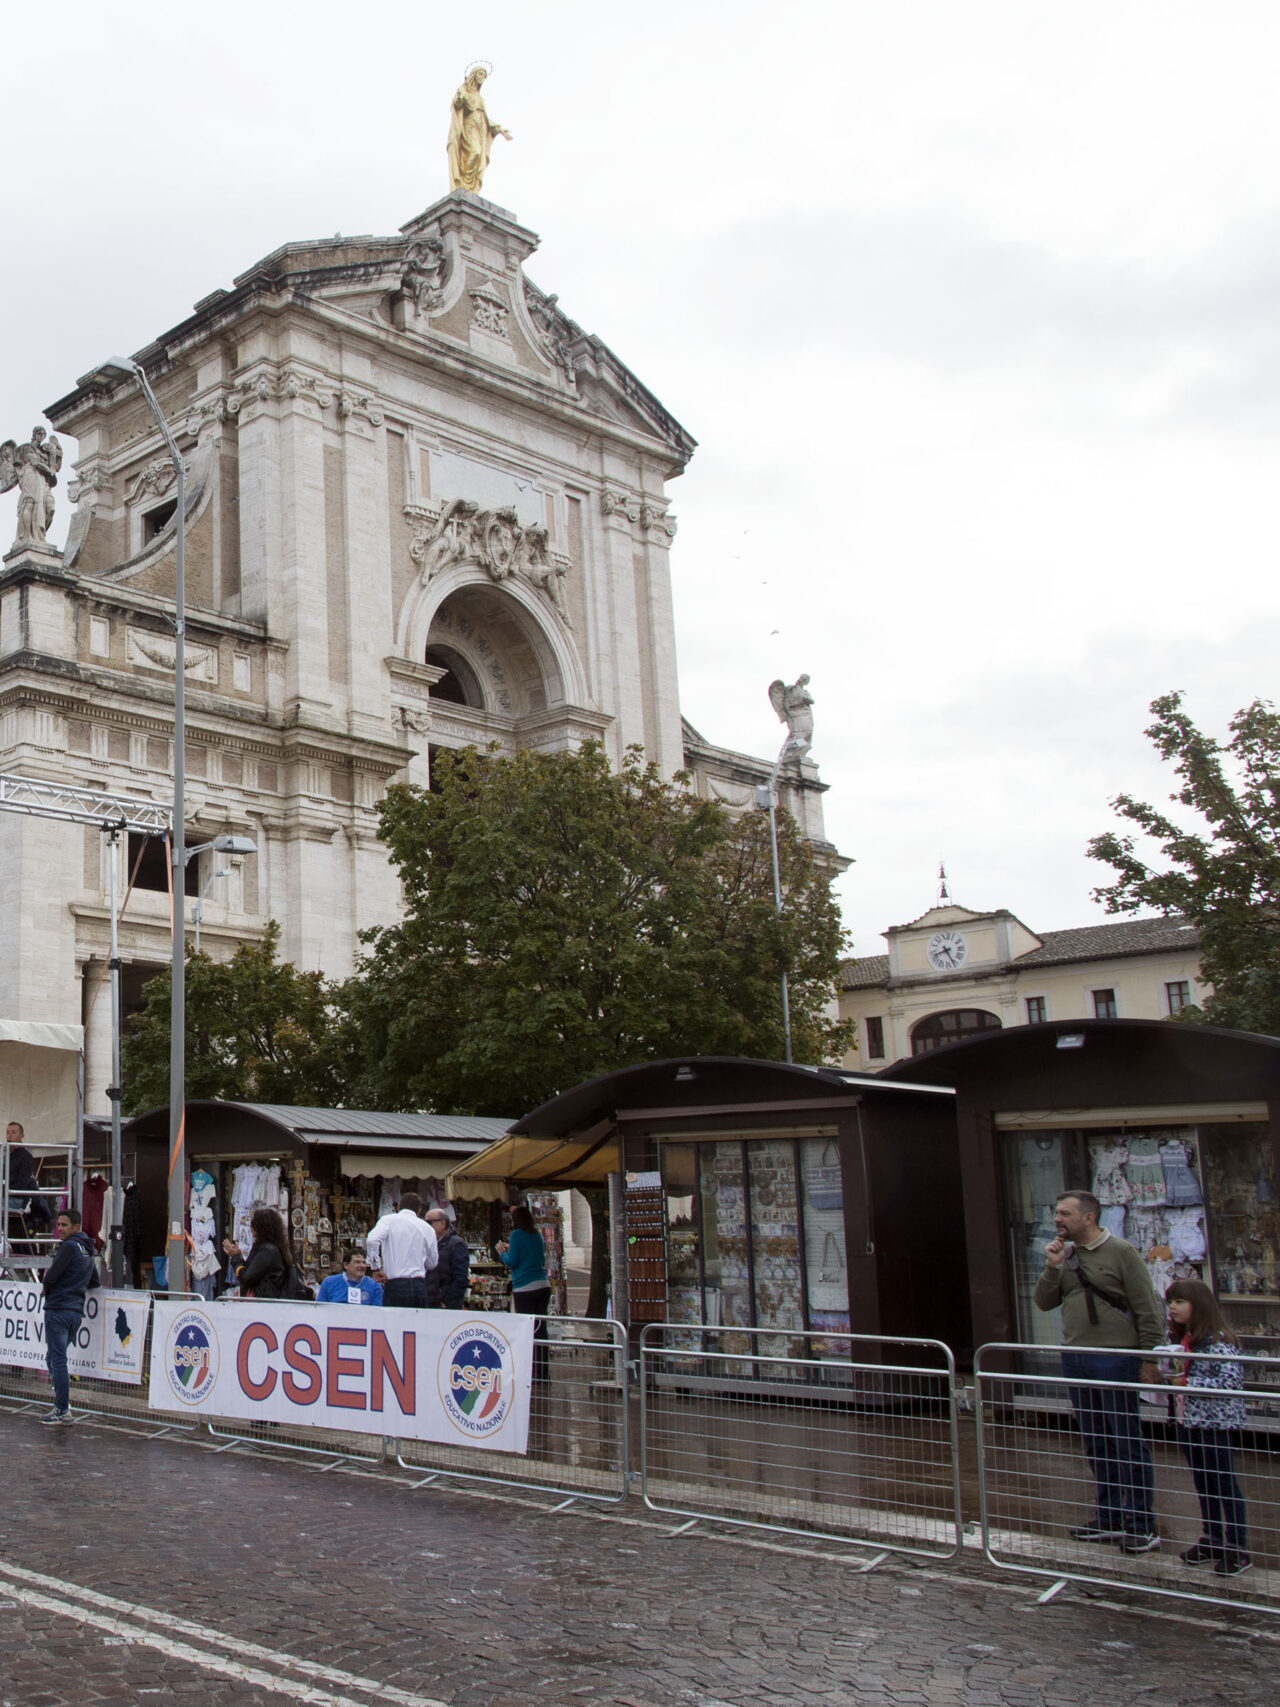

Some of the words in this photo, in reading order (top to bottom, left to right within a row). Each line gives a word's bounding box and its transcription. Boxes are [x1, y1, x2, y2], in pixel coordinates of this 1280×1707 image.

[26, 1295, 43, 1314] DI
[5, 1318, 31, 1342] DEL
[173, 1316, 191, 1334] CENTRO
[191, 1315, 211, 1336] SPORTIVO
[449, 1329, 475, 1350] CENTRO
[475, 1328, 506, 1355] SPORTIVO
[19, 1350, 48, 1361] COOPER
[68, 1357, 96, 1369] TALIANO
[173, 1345, 210, 1367] csen
[236, 1321, 416, 1417] CSEN
[449, 1364, 502, 1393] csen
[169, 1371, 192, 1399] EDUCATIVO
[191, 1373, 215, 1400] NAZIONALE
[444, 1394, 475, 1430] EDUCATIVO
[476, 1401, 507, 1432] NAZIONALE
